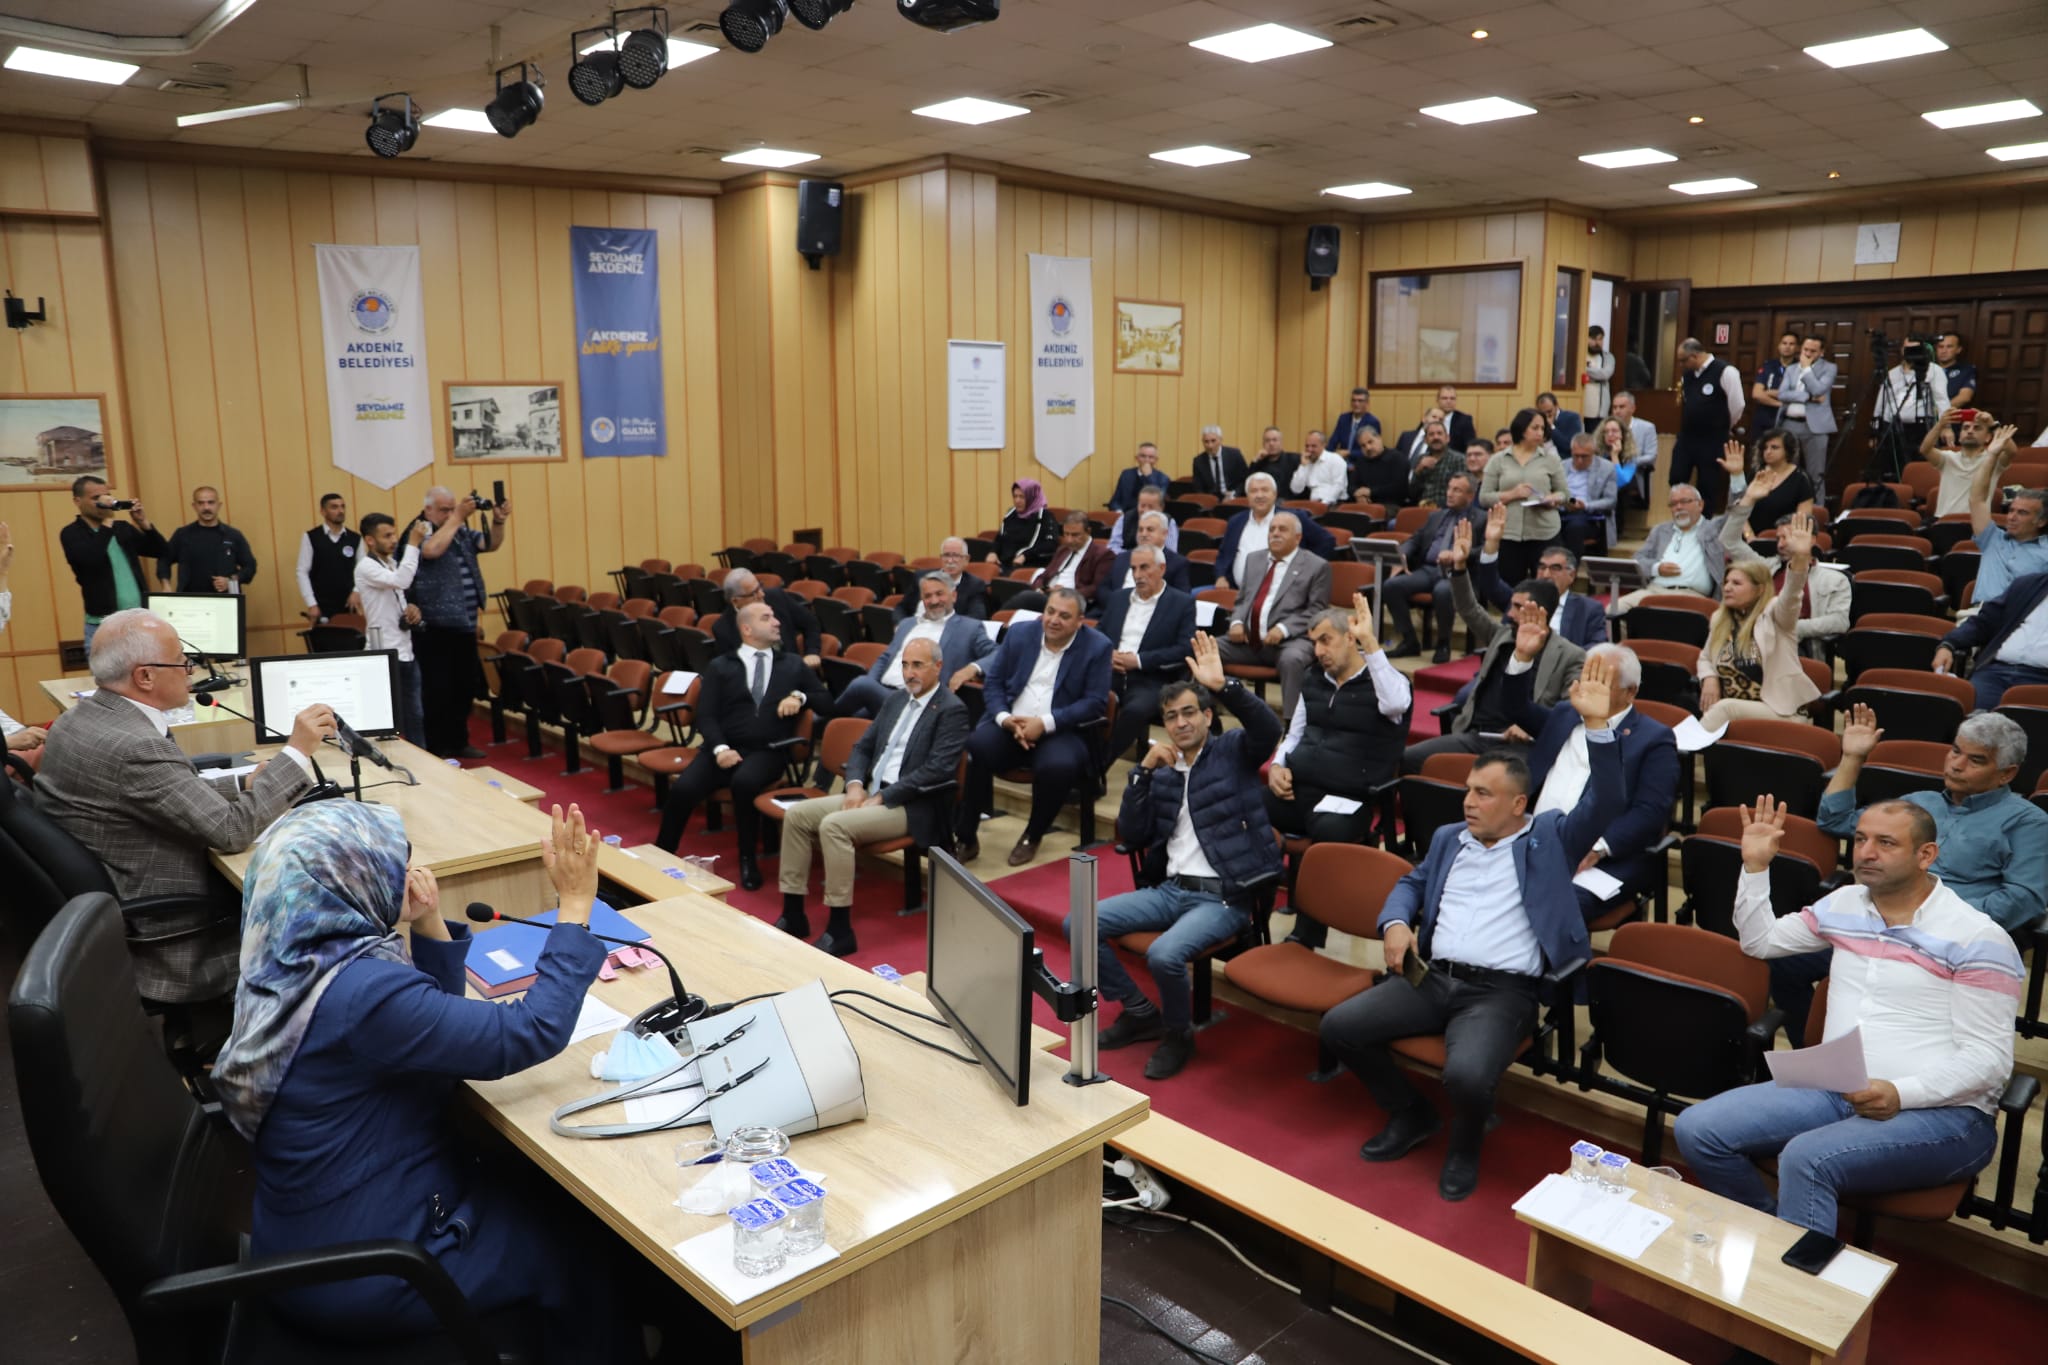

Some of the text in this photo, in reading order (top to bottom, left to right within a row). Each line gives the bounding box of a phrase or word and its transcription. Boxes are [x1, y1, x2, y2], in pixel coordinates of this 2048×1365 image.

[347, 340, 403, 353] AKDENİZ
[339, 356, 414, 368] BELEDİYESİ
[1038, 356, 1084, 368] BELEDİYESİ
